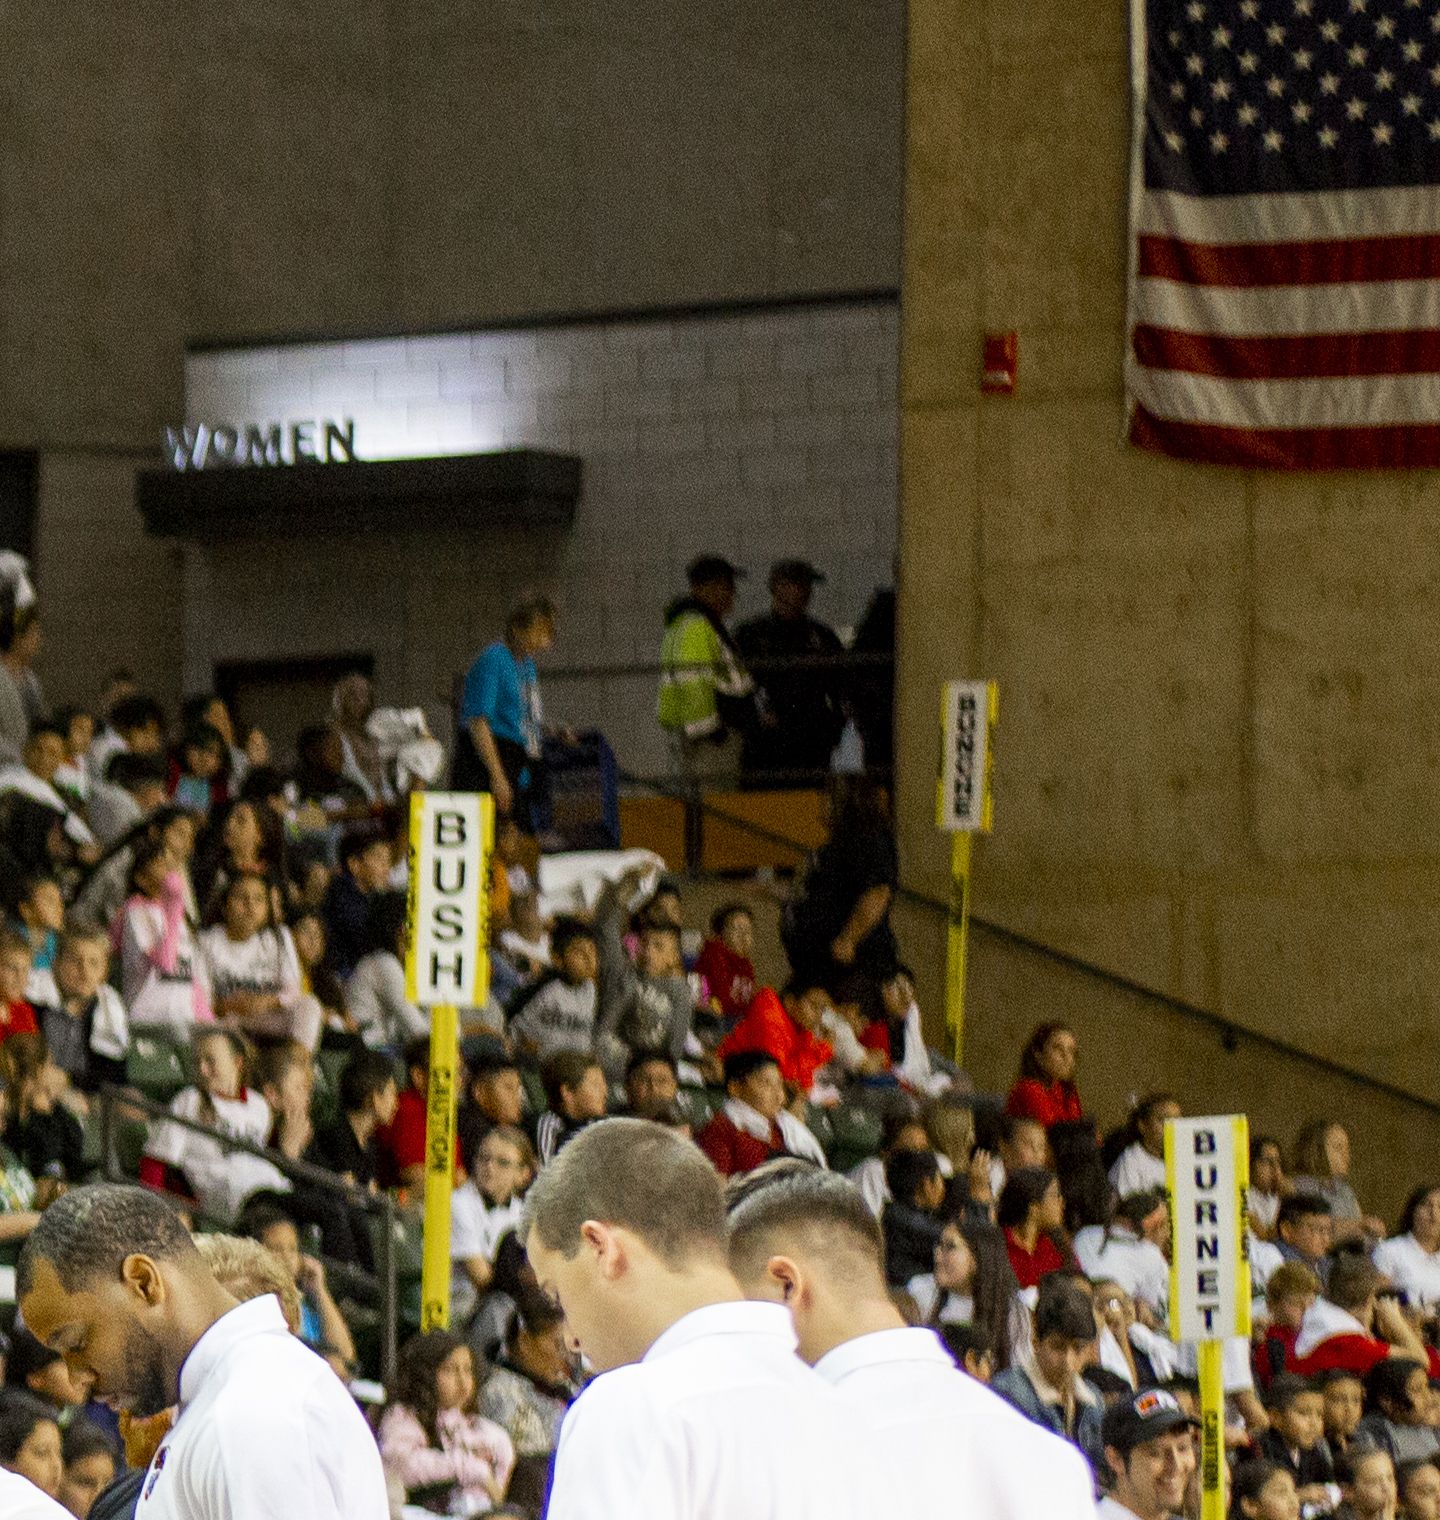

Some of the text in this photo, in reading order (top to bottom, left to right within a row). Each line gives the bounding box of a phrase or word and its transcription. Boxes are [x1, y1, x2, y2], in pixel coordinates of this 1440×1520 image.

[164, 417, 355, 472] WOMEN
[431, 810, 467, 989] BUSH
[1194, 1129, 1220, 1334] BURNET
